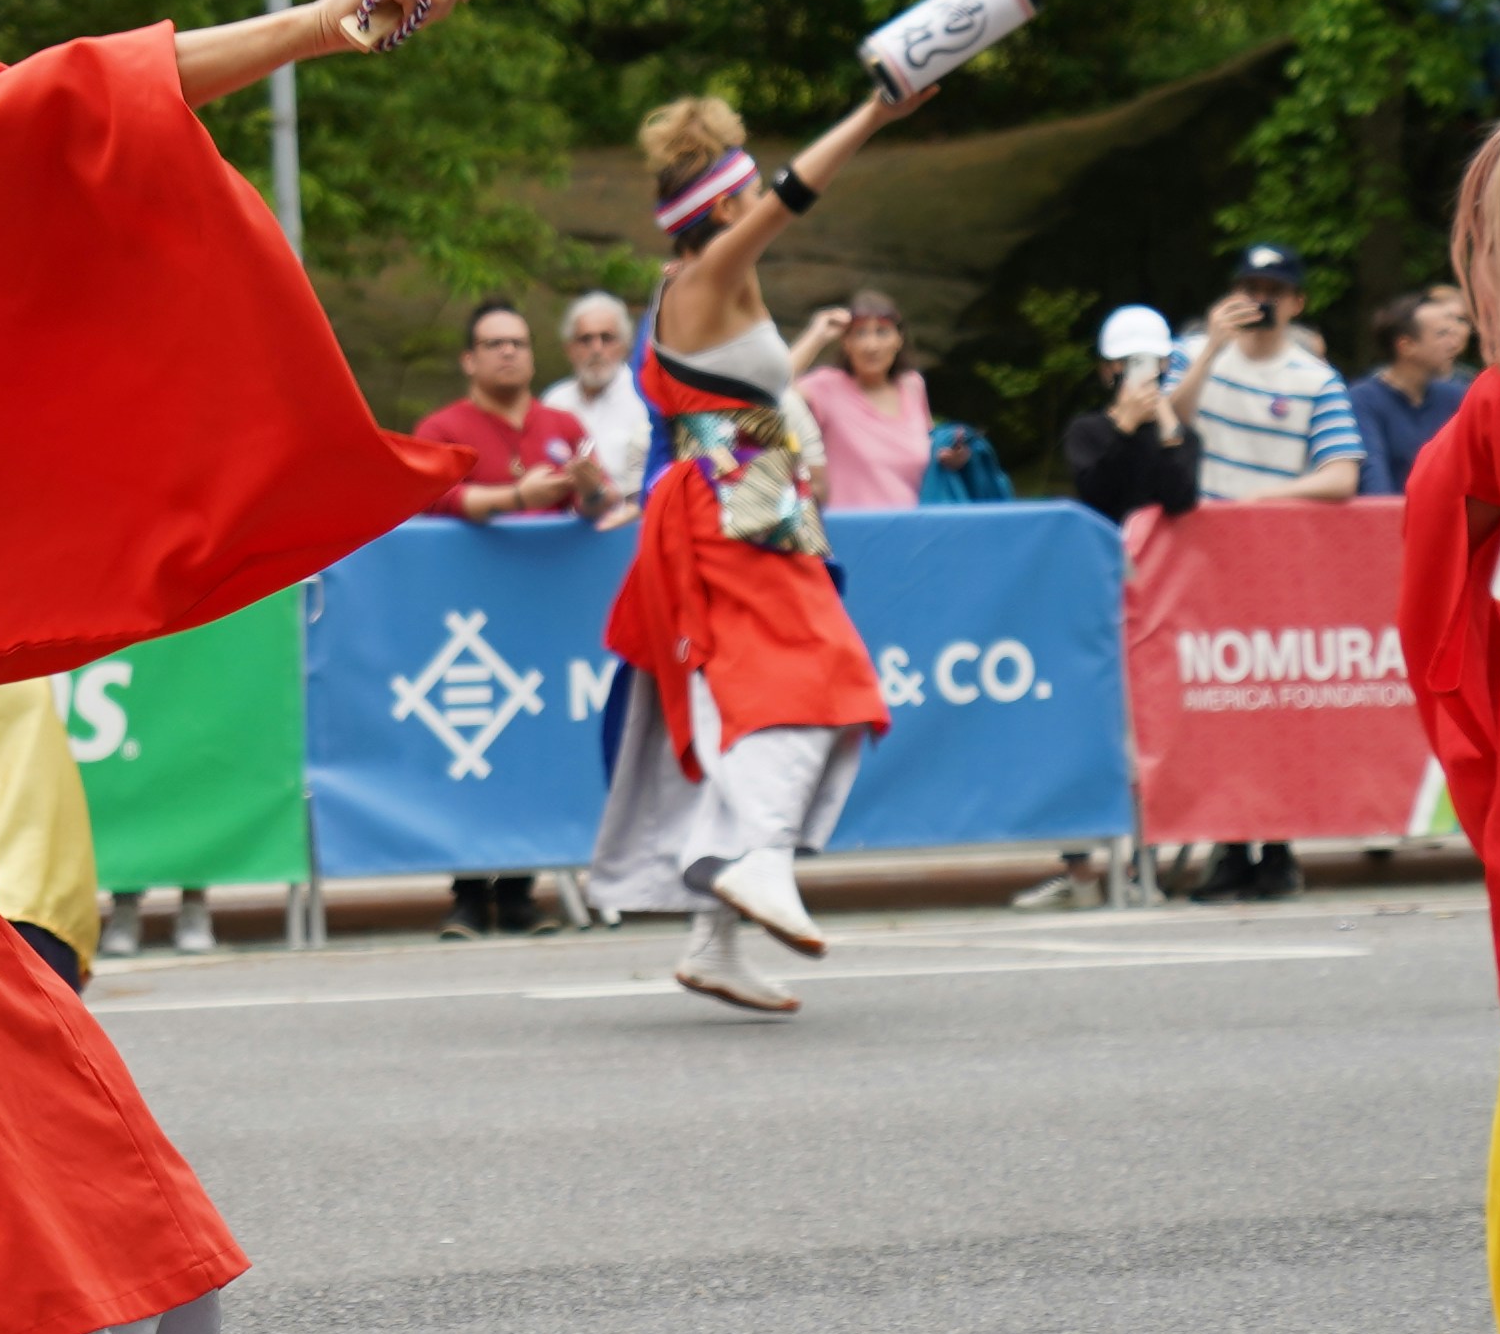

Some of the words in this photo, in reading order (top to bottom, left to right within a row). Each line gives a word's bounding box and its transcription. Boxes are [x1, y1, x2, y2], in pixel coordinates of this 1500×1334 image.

[878, 645, 926, 707] &
[934, 639, 1053, 705] CO.
[1178, 627, 1408, 683] NOMURA
[1183, 686, 1274, 711] AMERICA
